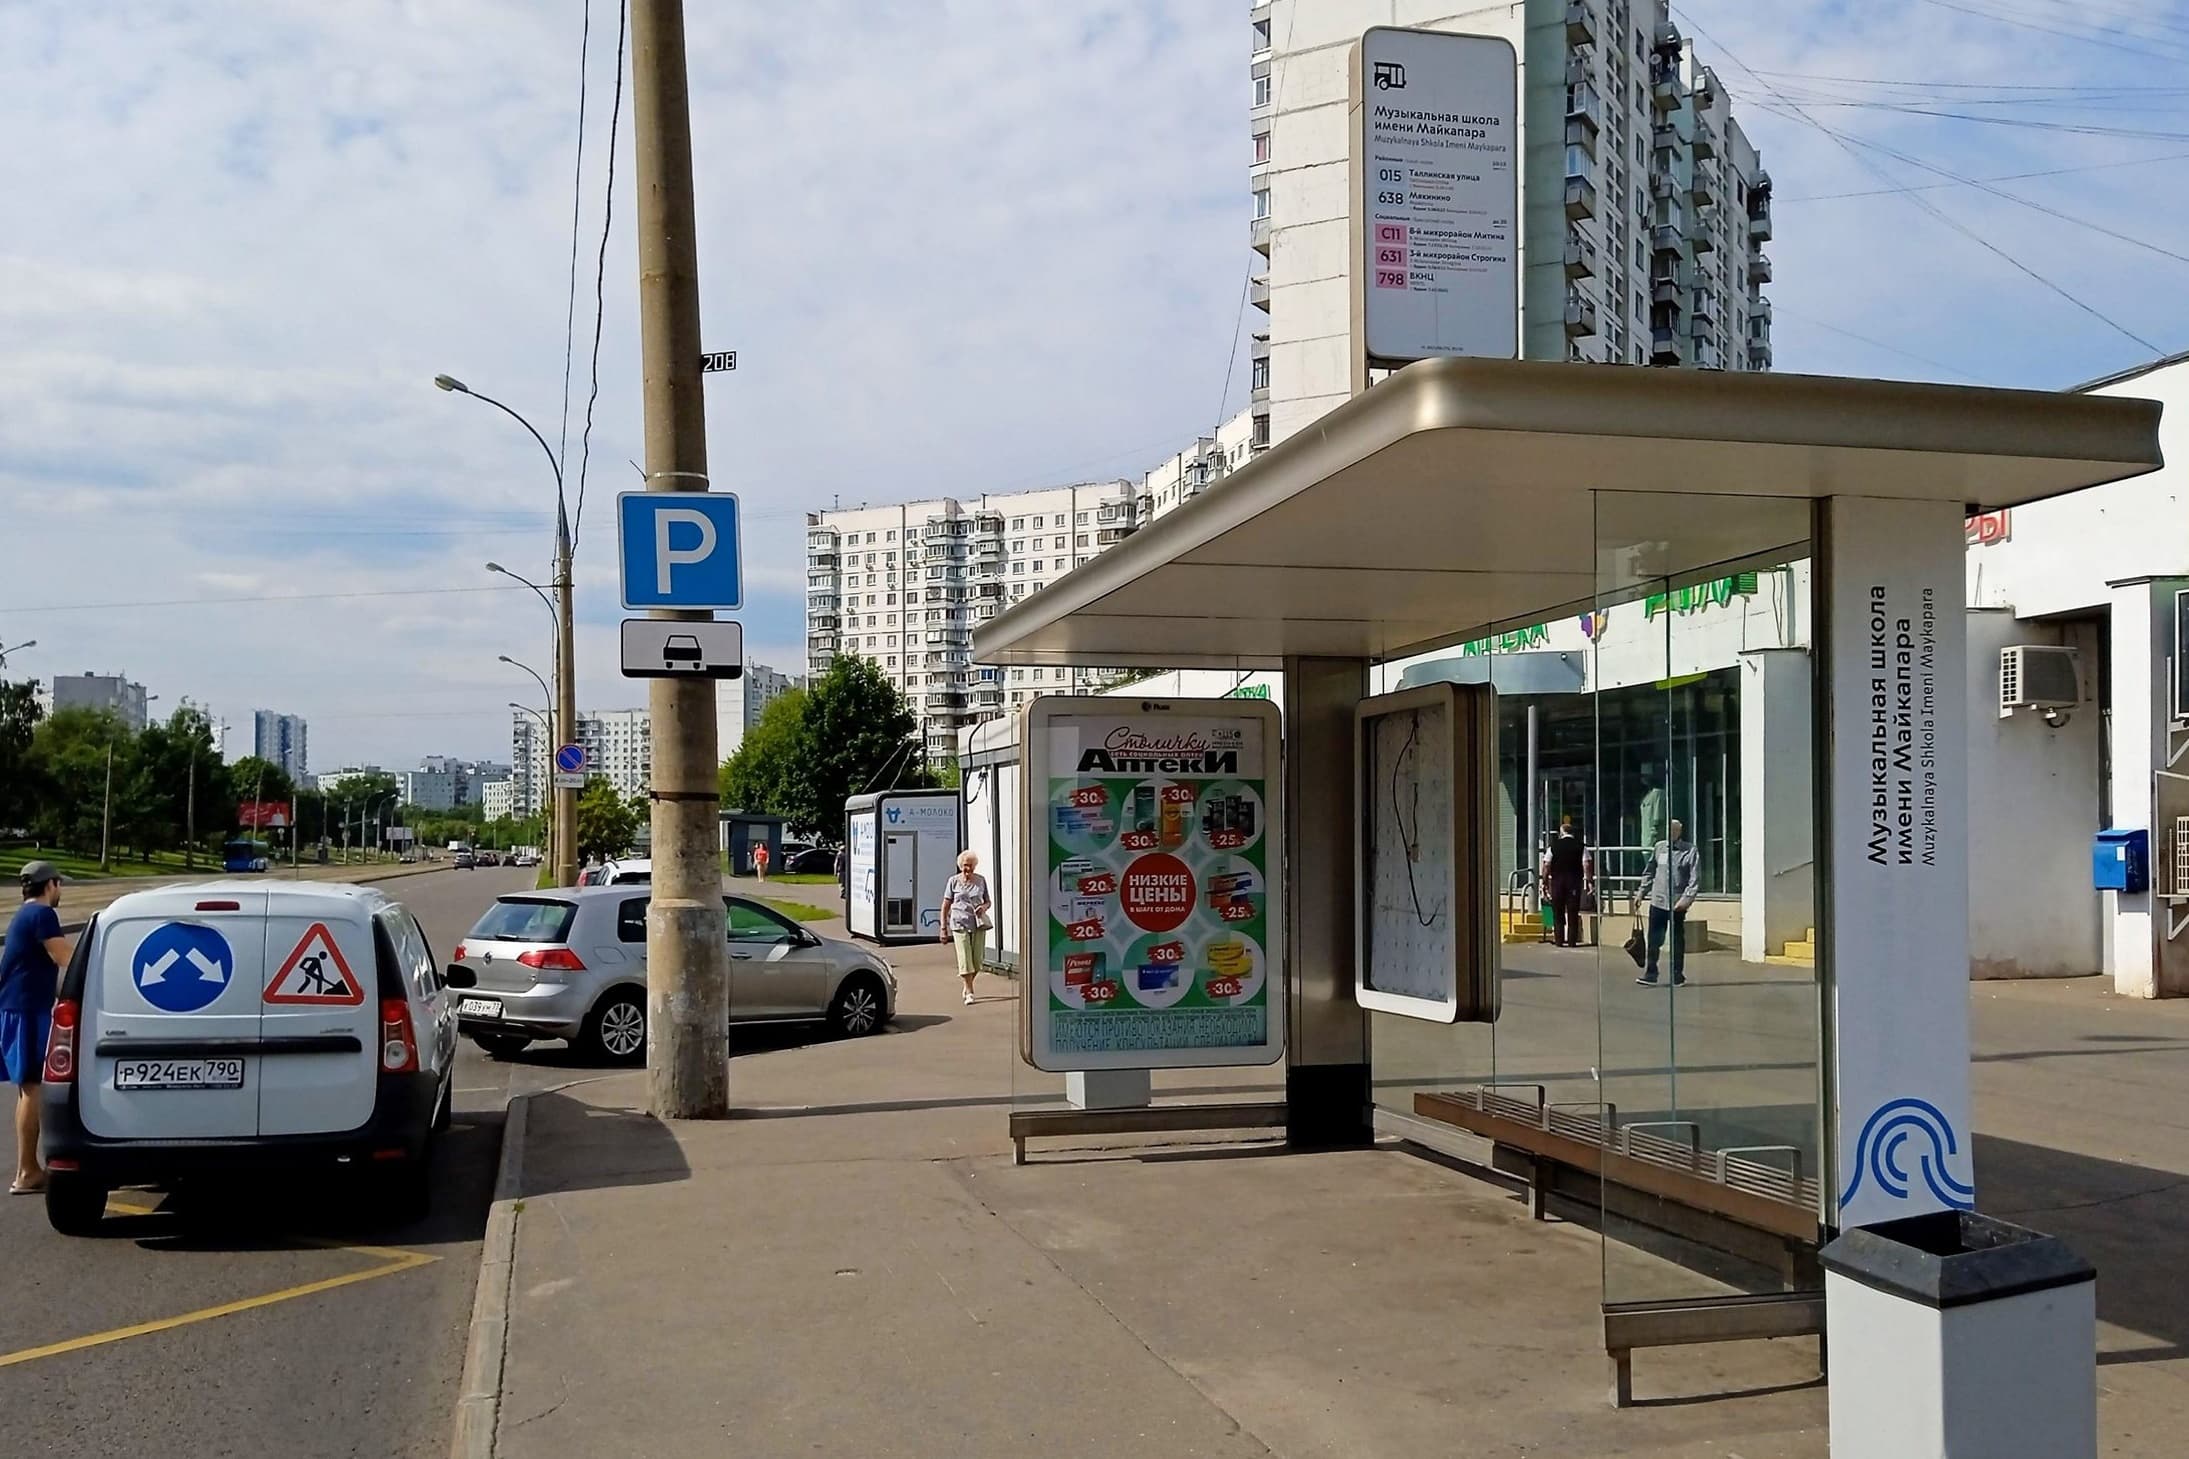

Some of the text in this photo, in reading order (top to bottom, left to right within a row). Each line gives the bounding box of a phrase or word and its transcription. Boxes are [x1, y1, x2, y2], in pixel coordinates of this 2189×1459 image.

[1375, 105, 1500, 126] Музыкальная школа
[1375, 121, 1486, 140] имени Майкапара
[1380, 168, 1402, 182] 015
[1379, 191, 1404, 205] 638
[1473, 231, 1505, 240] Митина
[1380, 249, 1402, 263] 631
[1379, 271, 1404, 286] 798
[703, 352, 735, 371] 208
[655, 508, 717, 595] P
[1867, 585, 1892, 866] Музыкальная школа
[1919, 587, 1938, 866] Muzykalnaya Shkola Imeni Maykapara
[1104, 726, 1211, 751] Столички
[1893, 618, 1915, 865] имени Майкапара
[1129, 874, 1187, 886] НИЗКИЕ
[1130, 887, 1187, 905] ЦЕНЫ
